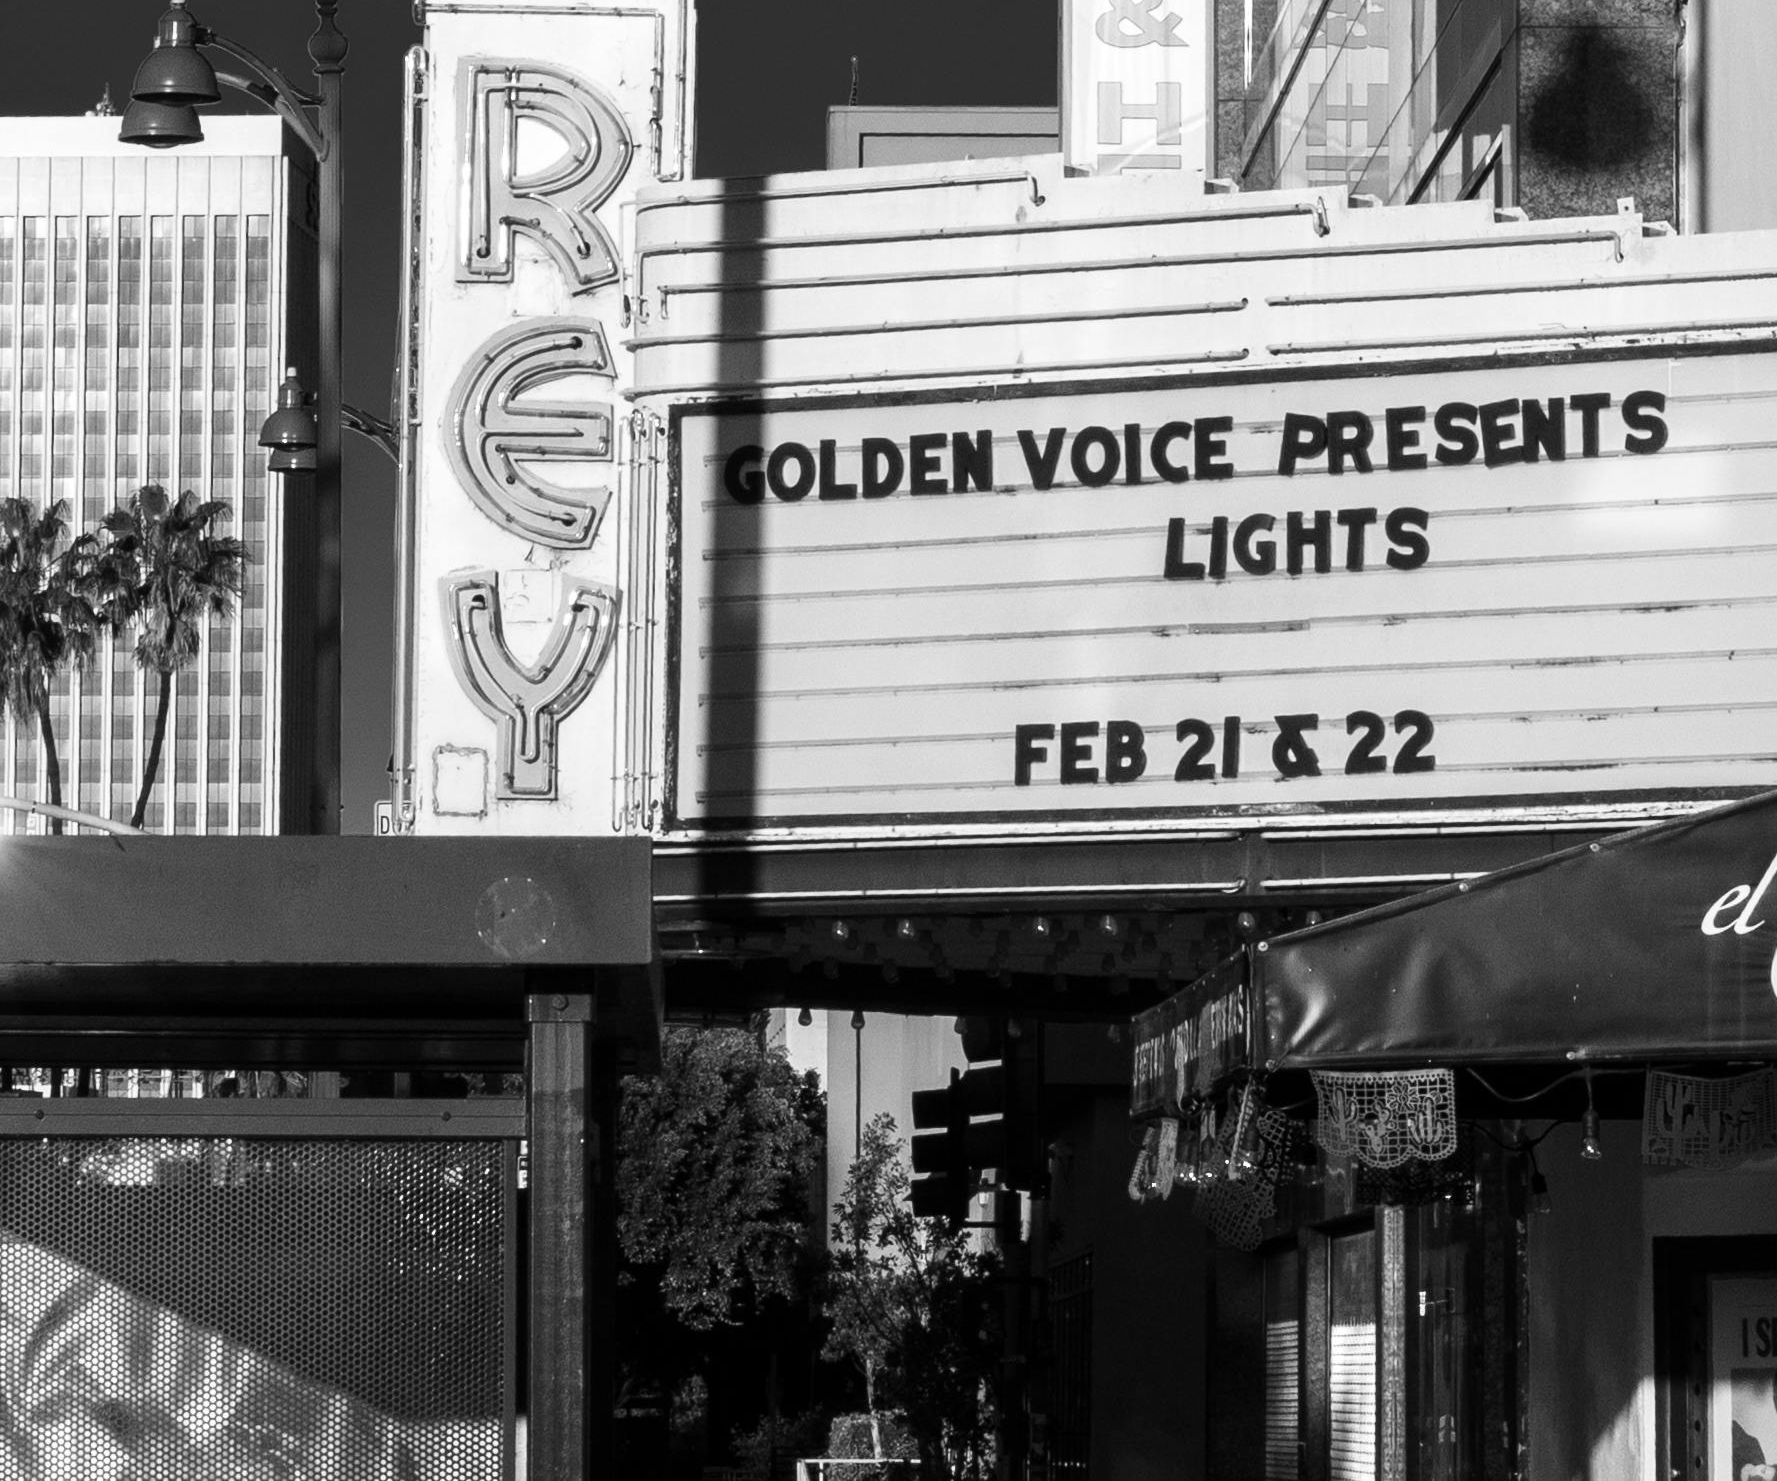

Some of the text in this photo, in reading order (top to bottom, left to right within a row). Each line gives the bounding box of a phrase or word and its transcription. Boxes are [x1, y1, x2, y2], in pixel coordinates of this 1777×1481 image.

[724, 390, 1669, 505] GOLDEN VOICE PRESENTS
[1163, 507, 1431, 580] LIGHTS
[1014, 709, 1437, 786] FEB 21 & 22
